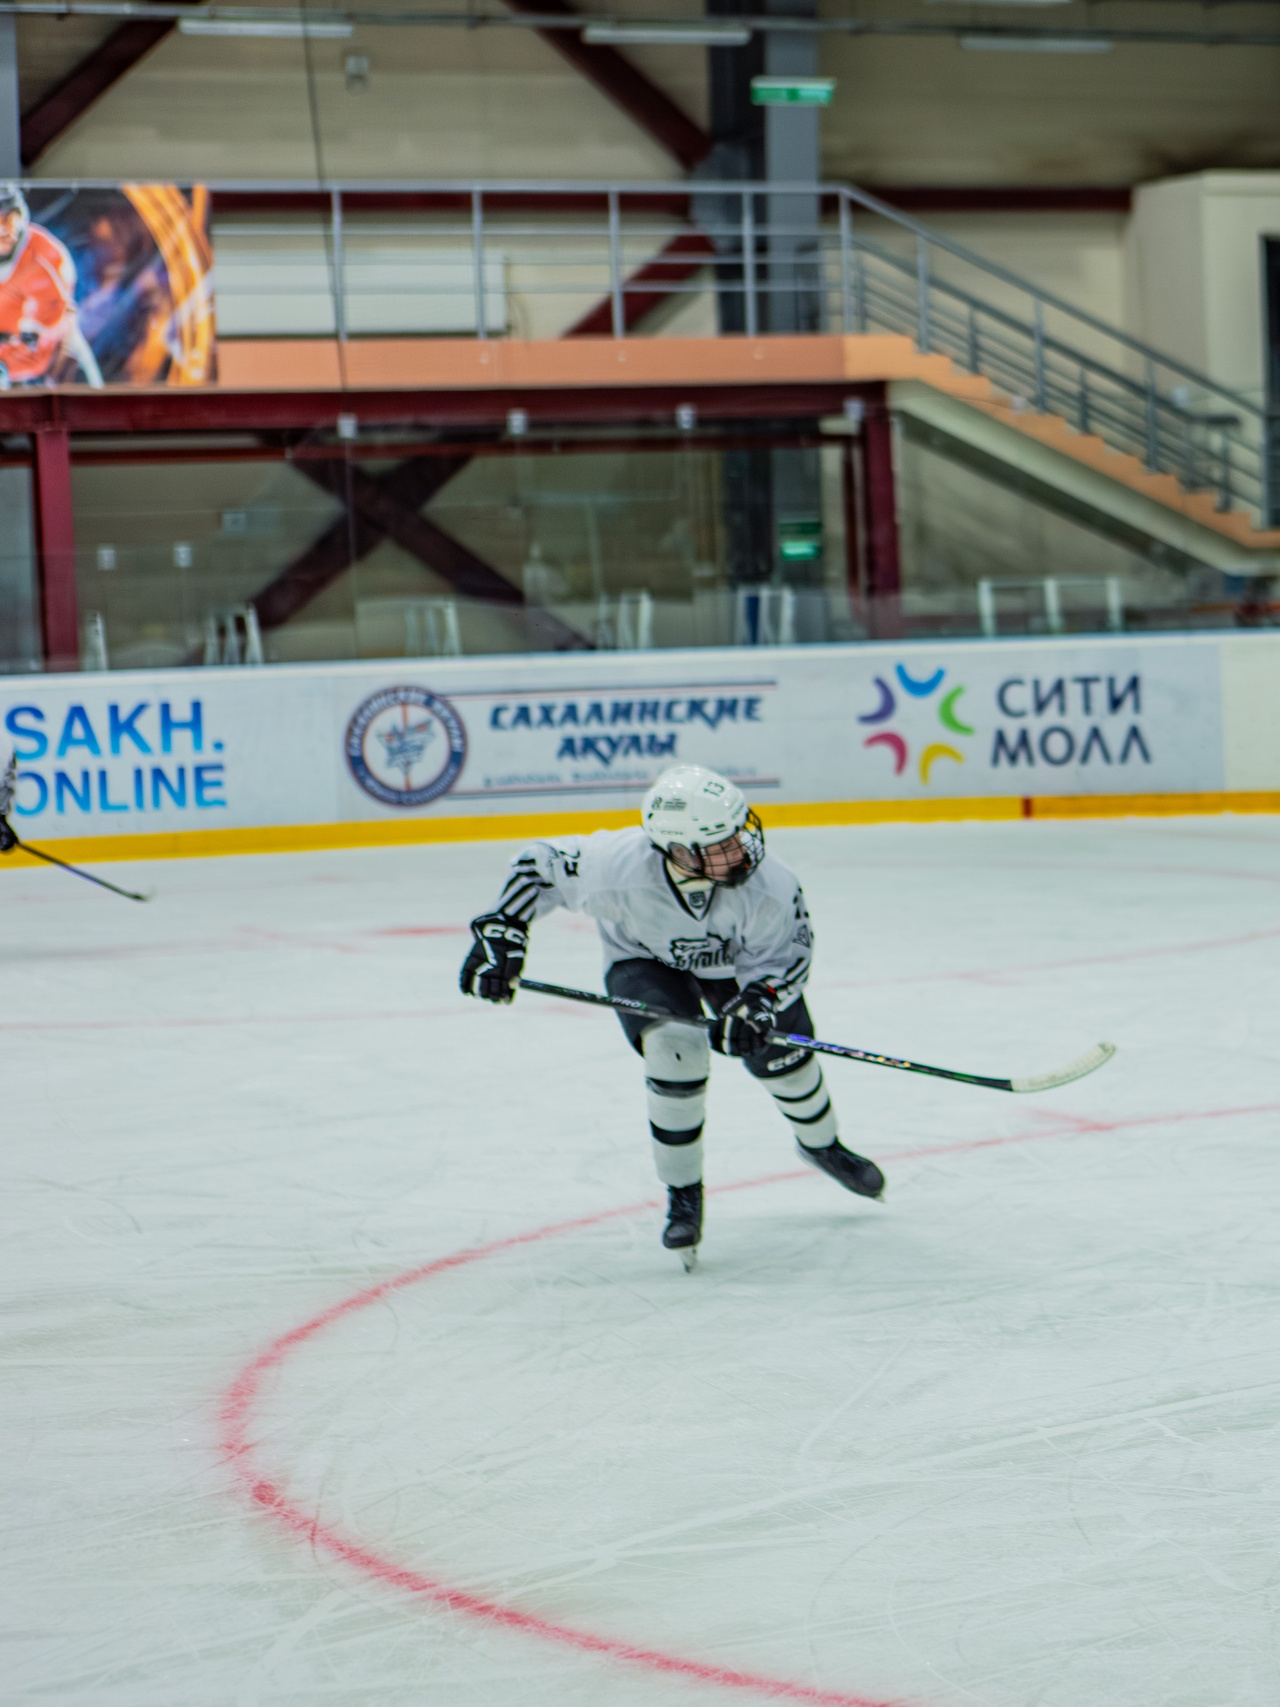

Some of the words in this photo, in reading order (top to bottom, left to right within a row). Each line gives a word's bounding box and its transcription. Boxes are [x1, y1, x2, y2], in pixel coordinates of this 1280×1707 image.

[488, 697, 763, 731] САХАЛИНСКИЕ
[996, 673, 1141, 718] СИТИ
[5, 700, 224, 760] SAKH.
[556, 732, 678, 766] АКУЛЫ
[990, 724, 1152, 768] МОЛЛ
[15, 763, 227, 817] ONLINE
[702, 781, 725, 797] 13
[482, 923, 529, 946] CC
